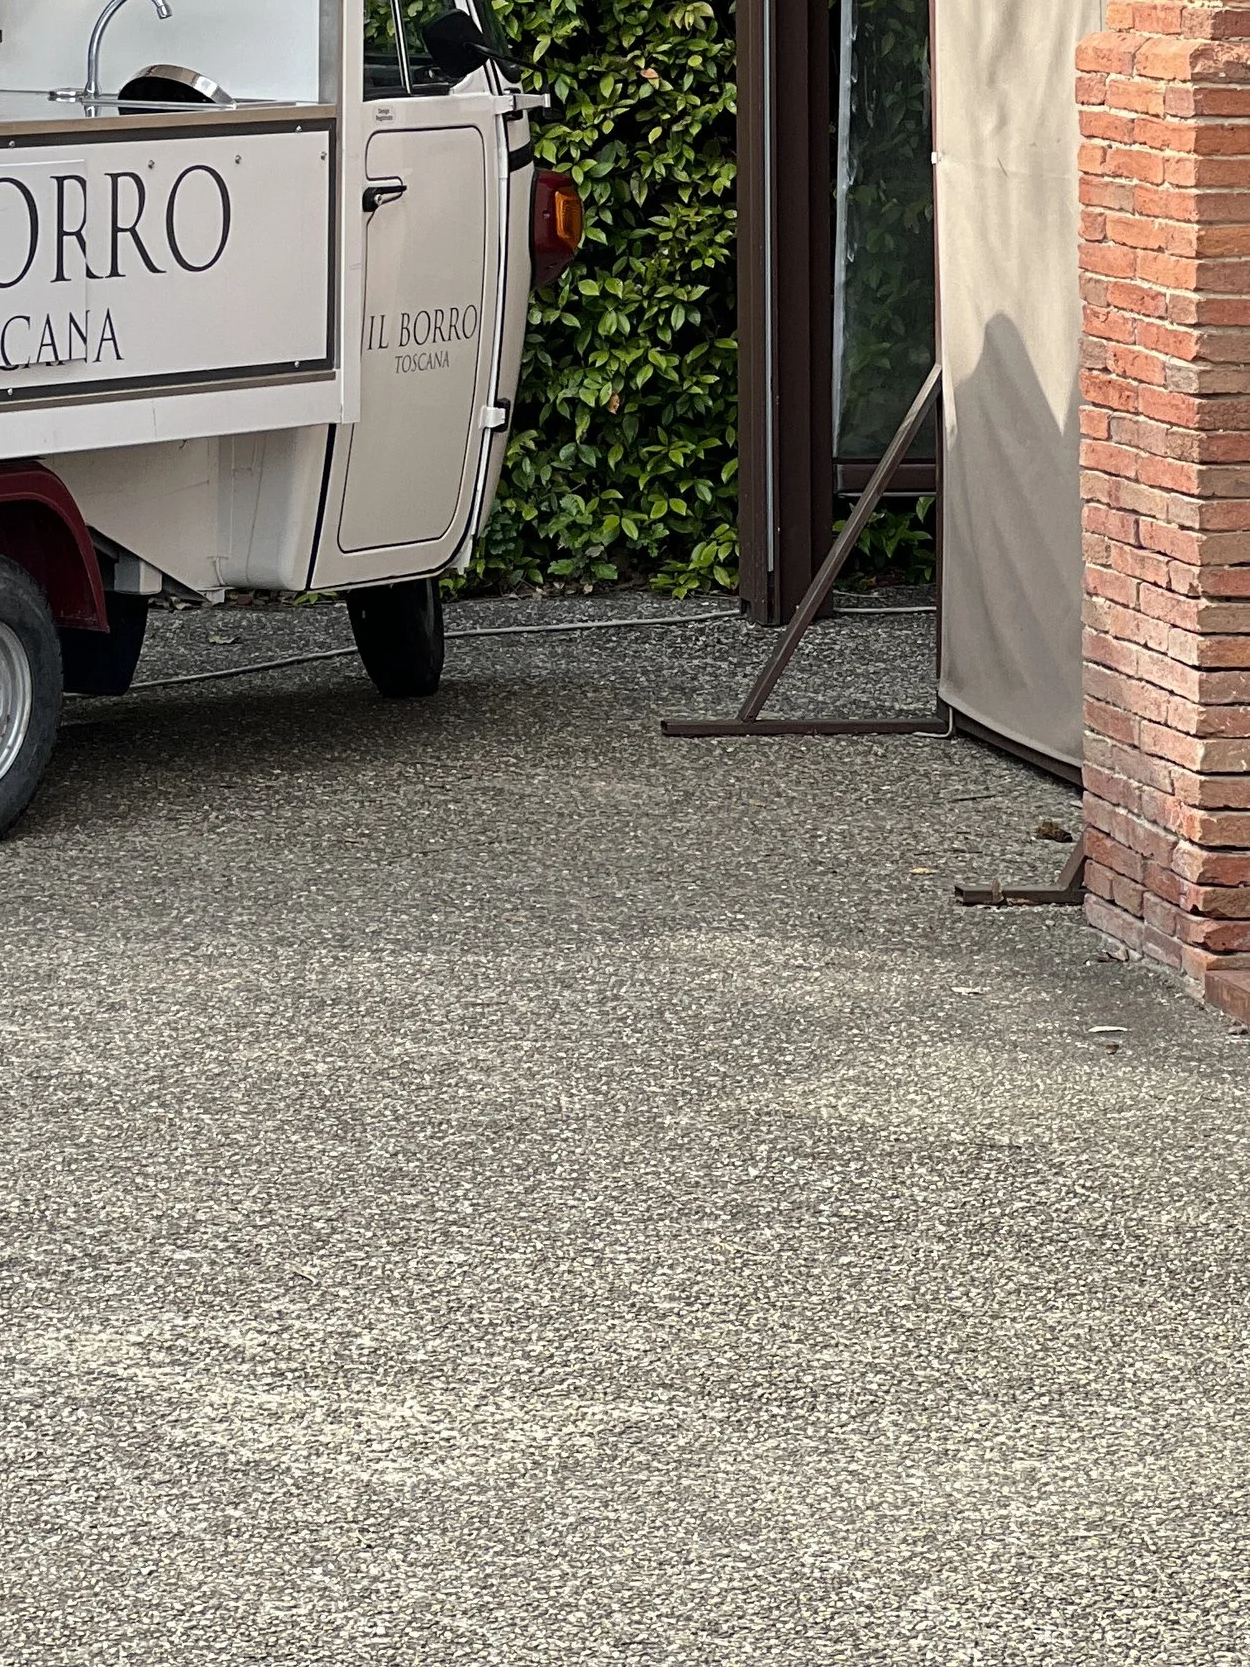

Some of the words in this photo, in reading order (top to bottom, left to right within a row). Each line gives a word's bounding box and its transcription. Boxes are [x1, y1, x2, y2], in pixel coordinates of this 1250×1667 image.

[367, 314, 389, 350] IL
[398, 304, 478, 347] BORRO
[395, 350, 450, 374] TOSCANA
